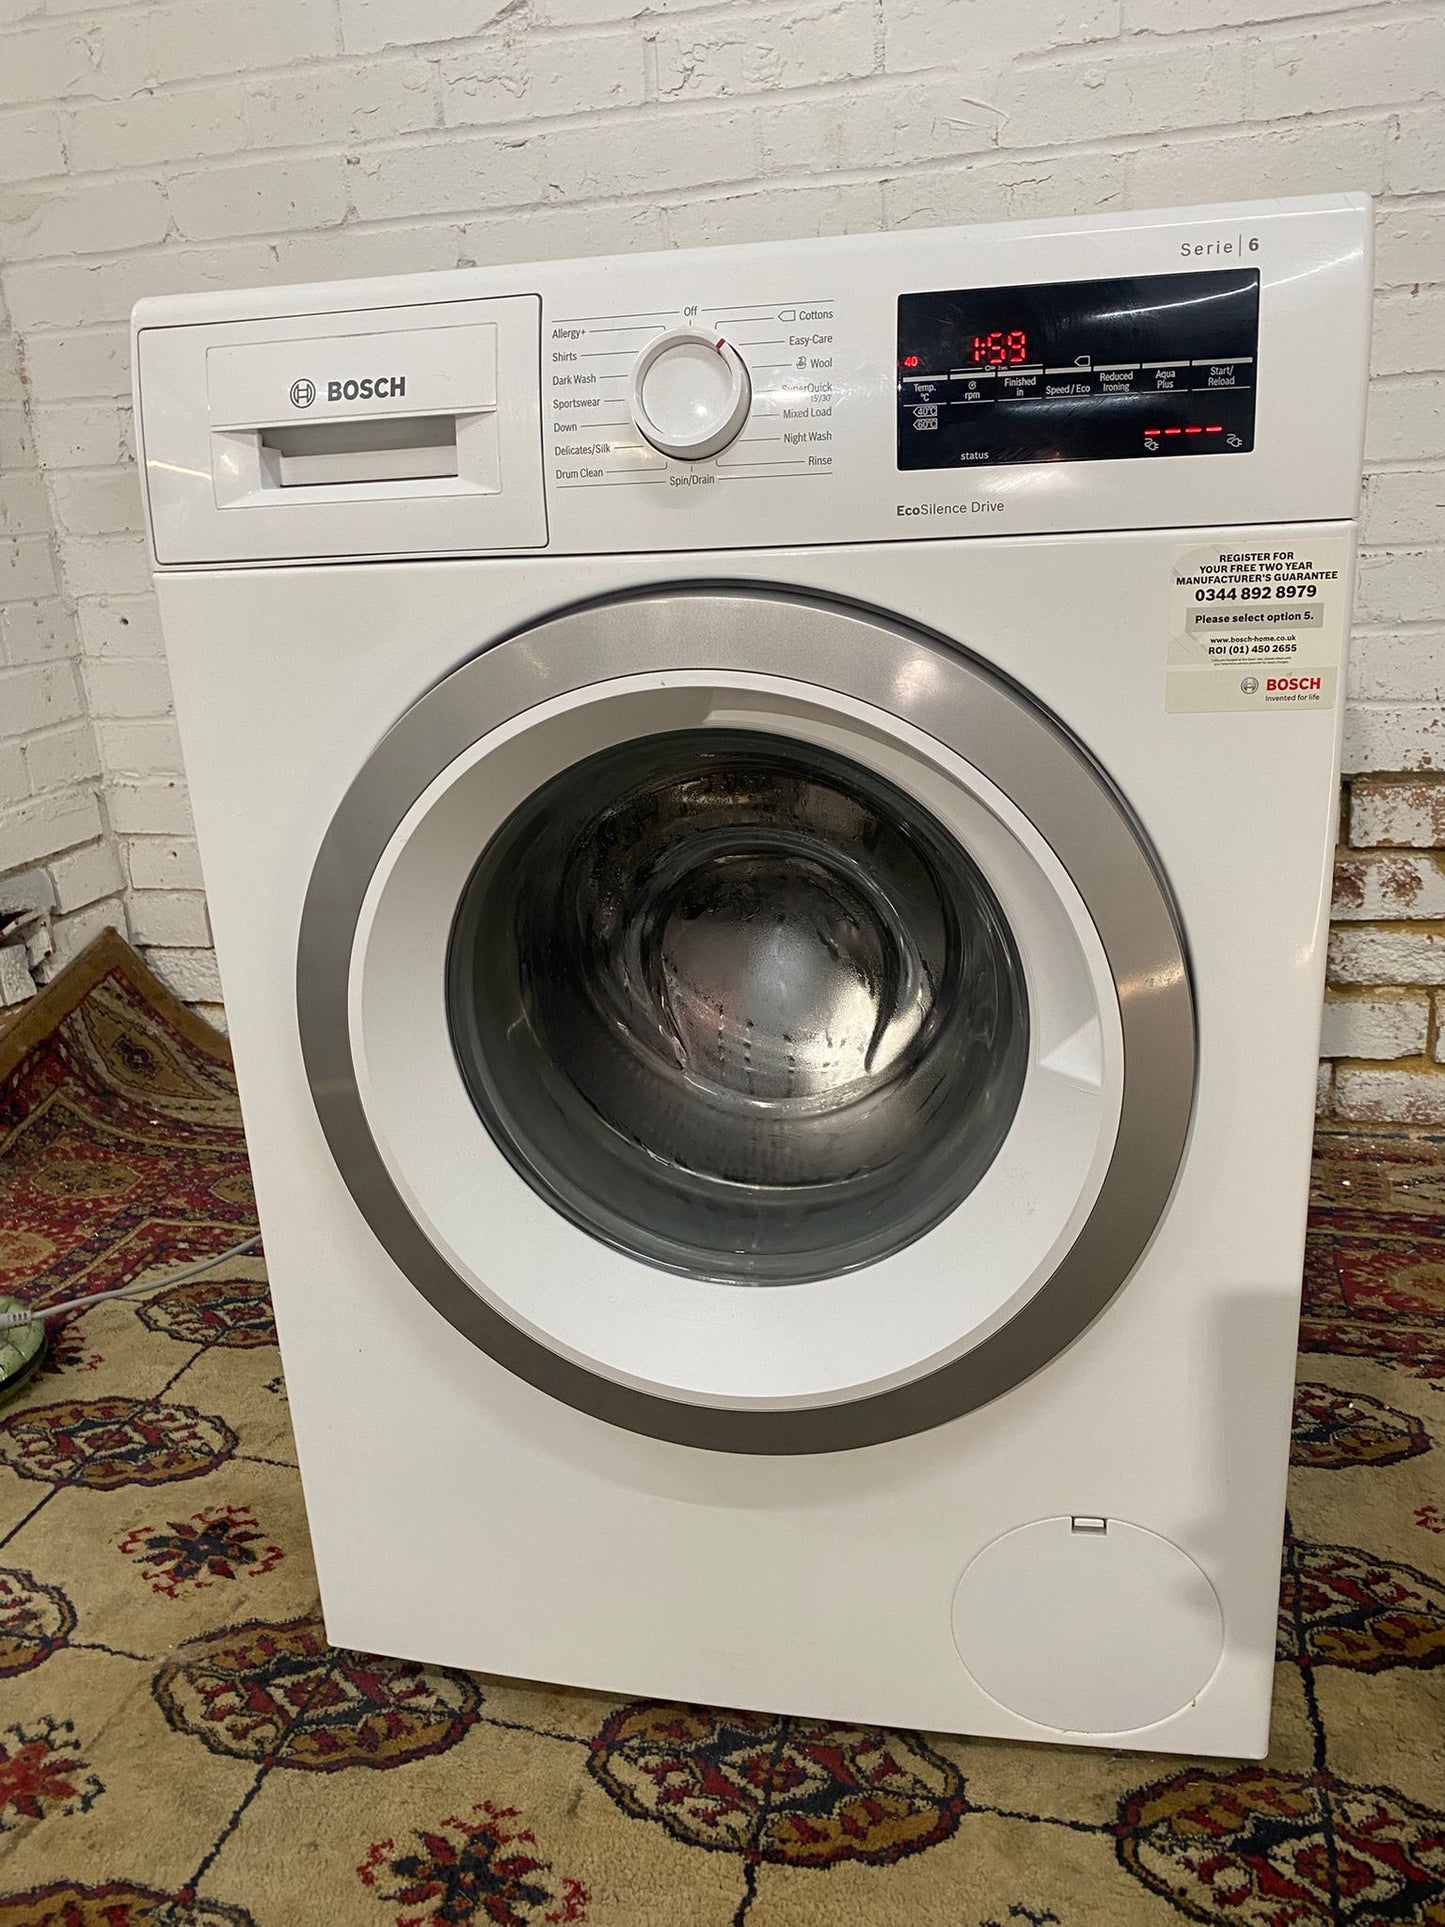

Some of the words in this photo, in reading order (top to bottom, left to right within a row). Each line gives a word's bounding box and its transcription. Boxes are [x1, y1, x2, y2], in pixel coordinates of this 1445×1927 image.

[1180, 240, 1233, 257] Serie
[1248, 237, 1260, 252] 6
[683, 306, 698, 317] Off
[798, 309, 834, 321] Cottons
[552, 329, 586, 340] Allergy+
[789, 333, 834, 347] Easy-Care
[973, 330, 1027, 364] 1:59
[552, 352, 578, 362] Shirts
[810, 357, 833, 368] Wool
[902, 355, 919, 367] 40
[1100, 371, 1134, 382] Reduced
[1155, 369, 1176, 381] Aqua
[1210, 365, 1234, 377] Start/
[552, 375, 572, 386] Dark
[573, 373, 597, 385] Wash
[1004, 376, 1037, 388] Finished
[1157, 380, 1174, 390] Plus
[1208, 375, 1236, 387] Reload
[327, 376, 406, 402] BOSCH
[913, 383, 937, 394] Temp.
[1016, 387, 1024, 397] in
[1045, 385, 1070, 396] Speed
[1076, 384, 1091, 394] Eco
[1103, 382, 1130, 393] Ironing
[964, 391, 981, 401] rpm
[552, 398, 601, 411] Sportswear
[783, 408, 809, 419] Mixed
[810, 405, 832, 417] Load
[553, 422, 578, 433] Down
[783, 432, 807, 445] Night
[808, 430, 833, 441] Wash
[554, 443, 611, 457] Delicates/Silk
[960, 451, 989, 461] status
[808, 456, 833, 467] Rinse
[555, 468, 579, 480] Drum
[580, 467, 604, 478] Clean
[669, 475, 715, 488] Spin/Drain
[896, 503, 967, 516] EcoSilence
[971, 501, 1005, 513] Drive
[1219, 553, 1271, 563] REGISTER
[1273, 551, 1294, 561] FOR
[1199, 565, 1228, 574] YOUR
[1230, 563, 1257, 573] FREE
[1258, 562, 1283, 572] TWO
[1284, 561, 1313, 571] YEAR
[1176, 574, 1272, 586] MANUFACTURER'S
[1274, 570, 1338, 582] GUARANTEE
[1195, 587, 1237, 602] 0344
[1240, 586, 1271, 600] 892
[1275, 584, 1317, 599] 8979
[1195, 614, 1230, 624] Please
[1232, 613, 1265, 623] select
[1266, 611, 1301, 624] option
[1303, 611, 1314, 621] 5.
[1209, 634, 1297, 644] www.bosch-home.co.uk
[1208, 645, 1226, 655] ROI
[1228, 645, 1250, 656] (01)
[1251, 644, 1270, 653] 450
[1272, 643, 1297, 653] 2655
[1266, 677, 1321, 691] BOSCH
[1308, 693, 1320, 701] life
